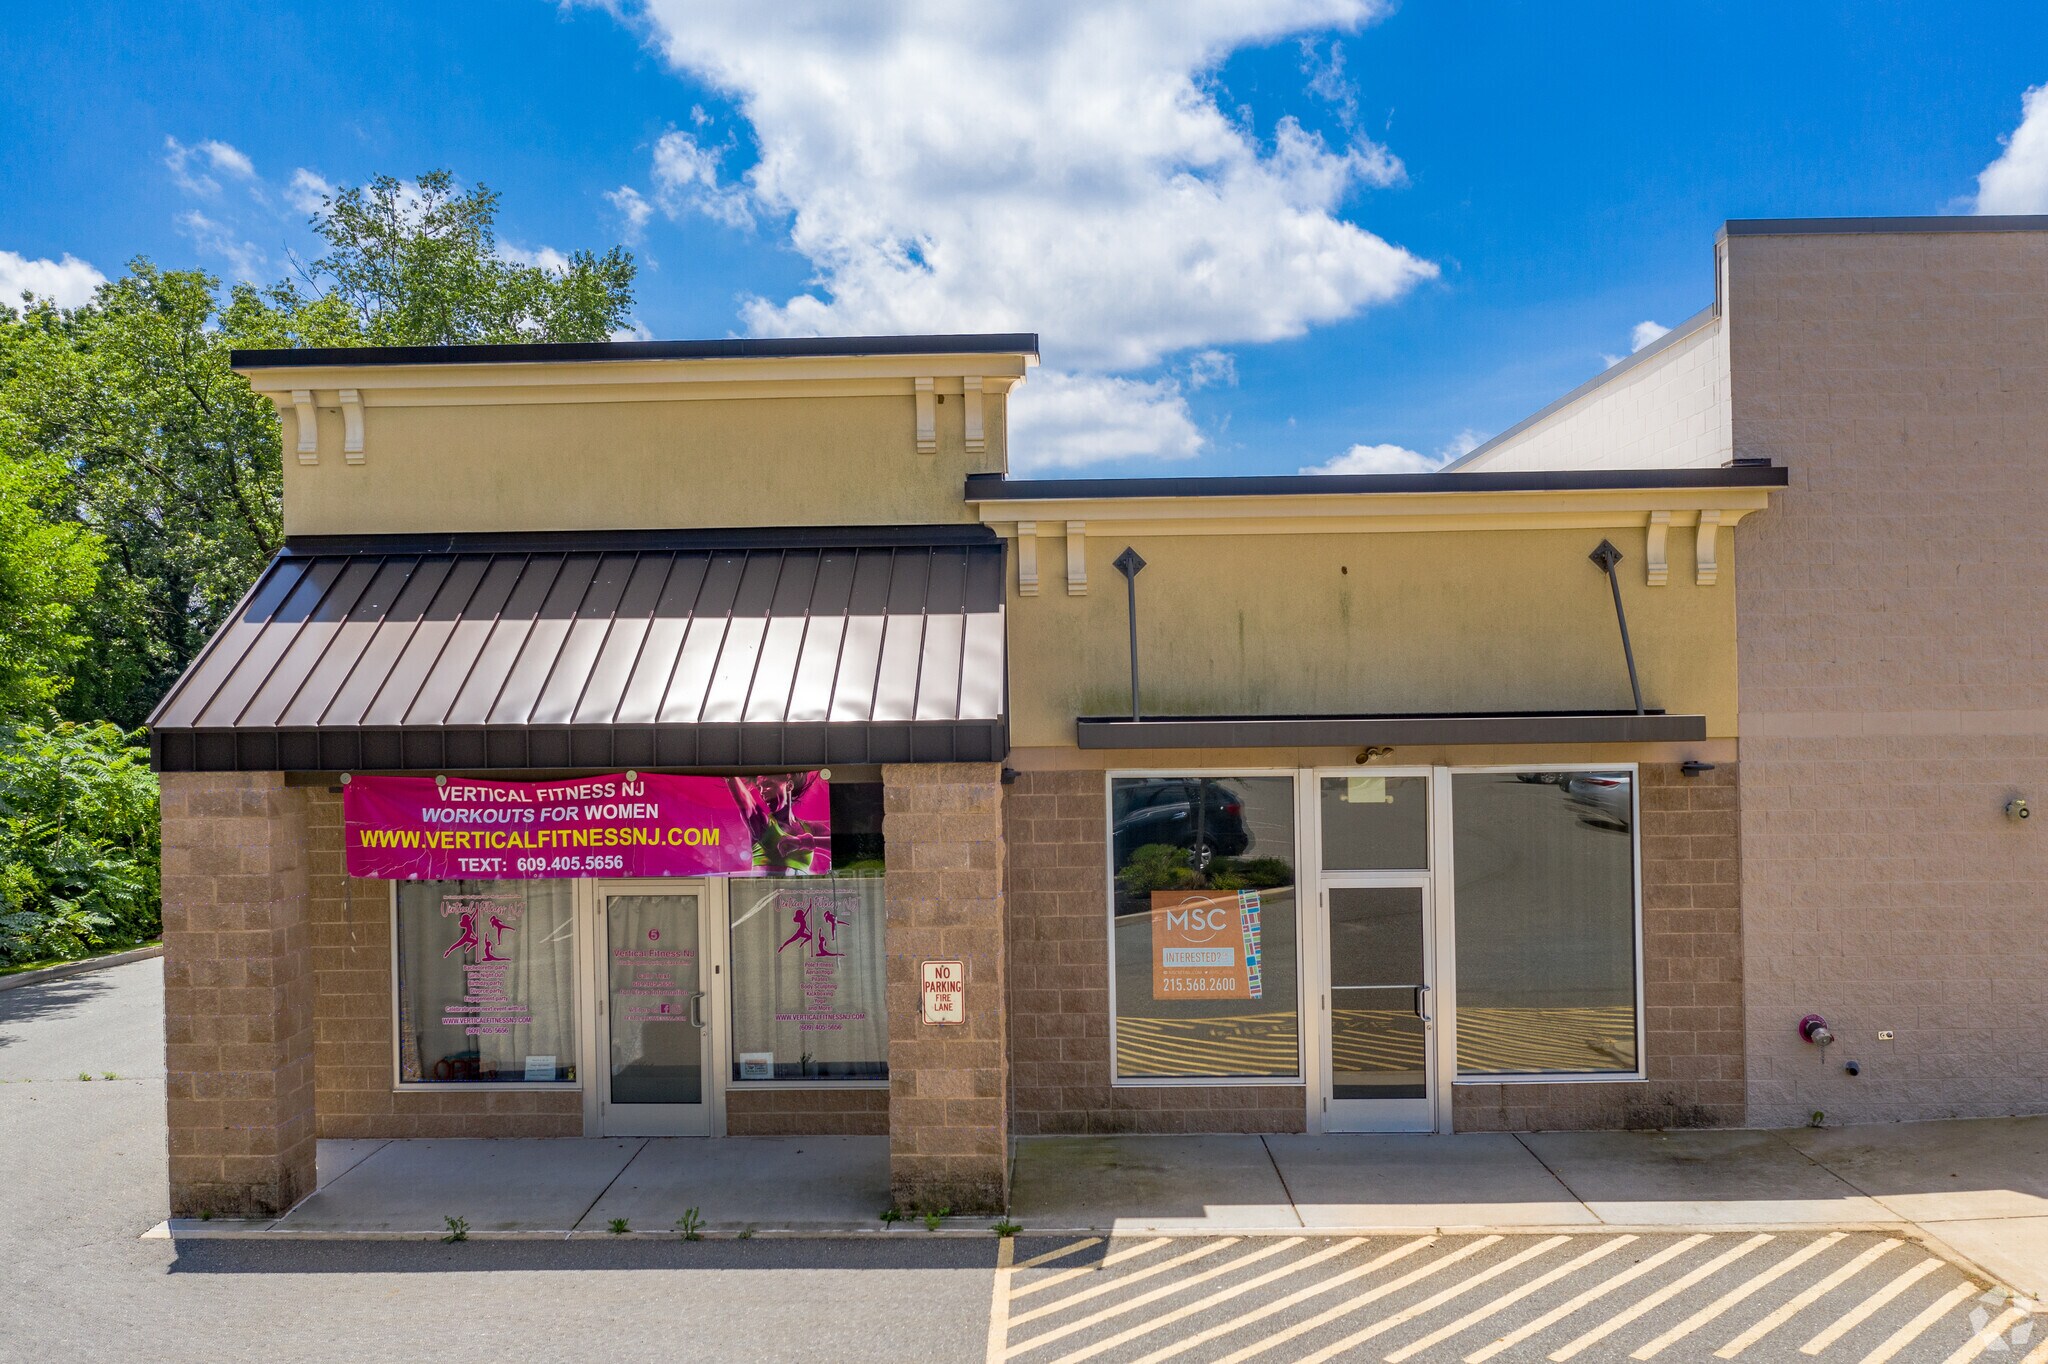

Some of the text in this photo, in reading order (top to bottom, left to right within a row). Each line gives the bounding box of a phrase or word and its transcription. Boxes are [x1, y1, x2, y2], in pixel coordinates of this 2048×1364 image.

[438, 781, 645, 802] VERTICAL FITNESS NJ
[422, 803, 659, 823] WORKOUTS FOR WOMEN
[360, 827, 720, 849] WWW.VERTICALFITNESSNJ.COM
[458, 854, 624, 872] TEXT: 609.405.5656
[1166, 908, 1227, 931] MSC
[614, 949, 695, 957] Vertical Fitness NJ
[1165, 952, 1222, 963] INTERESTED?
[935, 967, 951, 979] NO
[925, 981, 961, 993] PARKING
[1163, 978, 1235, 992] 215.568.2600
[935, 994, 951, 1002] FIRE
[934, 1003, 953, 1011] LANE
